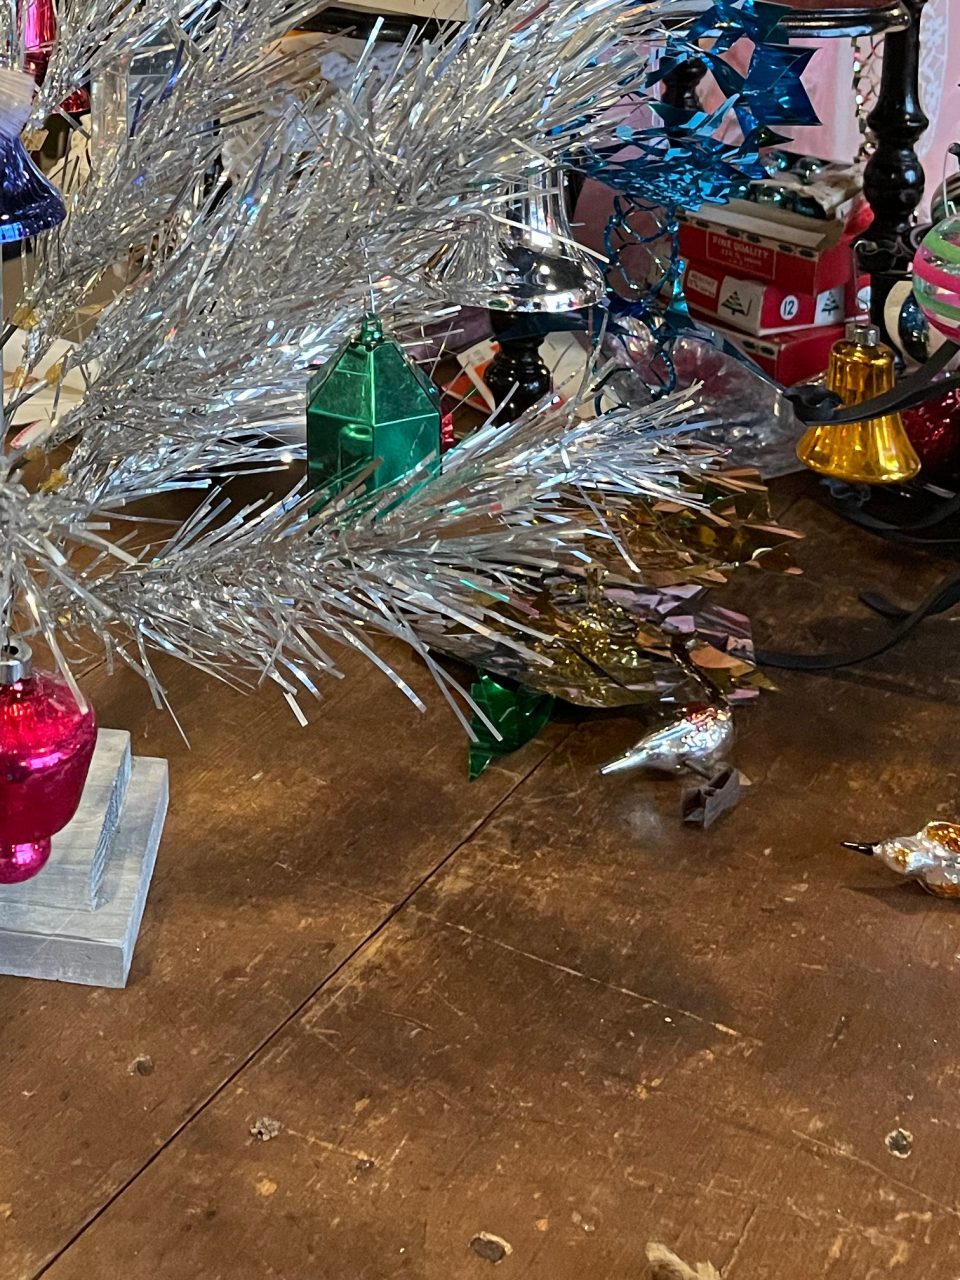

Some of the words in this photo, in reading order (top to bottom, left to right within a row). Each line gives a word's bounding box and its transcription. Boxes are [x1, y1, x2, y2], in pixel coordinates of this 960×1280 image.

[712, 235, 732, 249] FINE
[733, 241, 769, 259] QUALITY
[783, 300, 795, 316] 12
